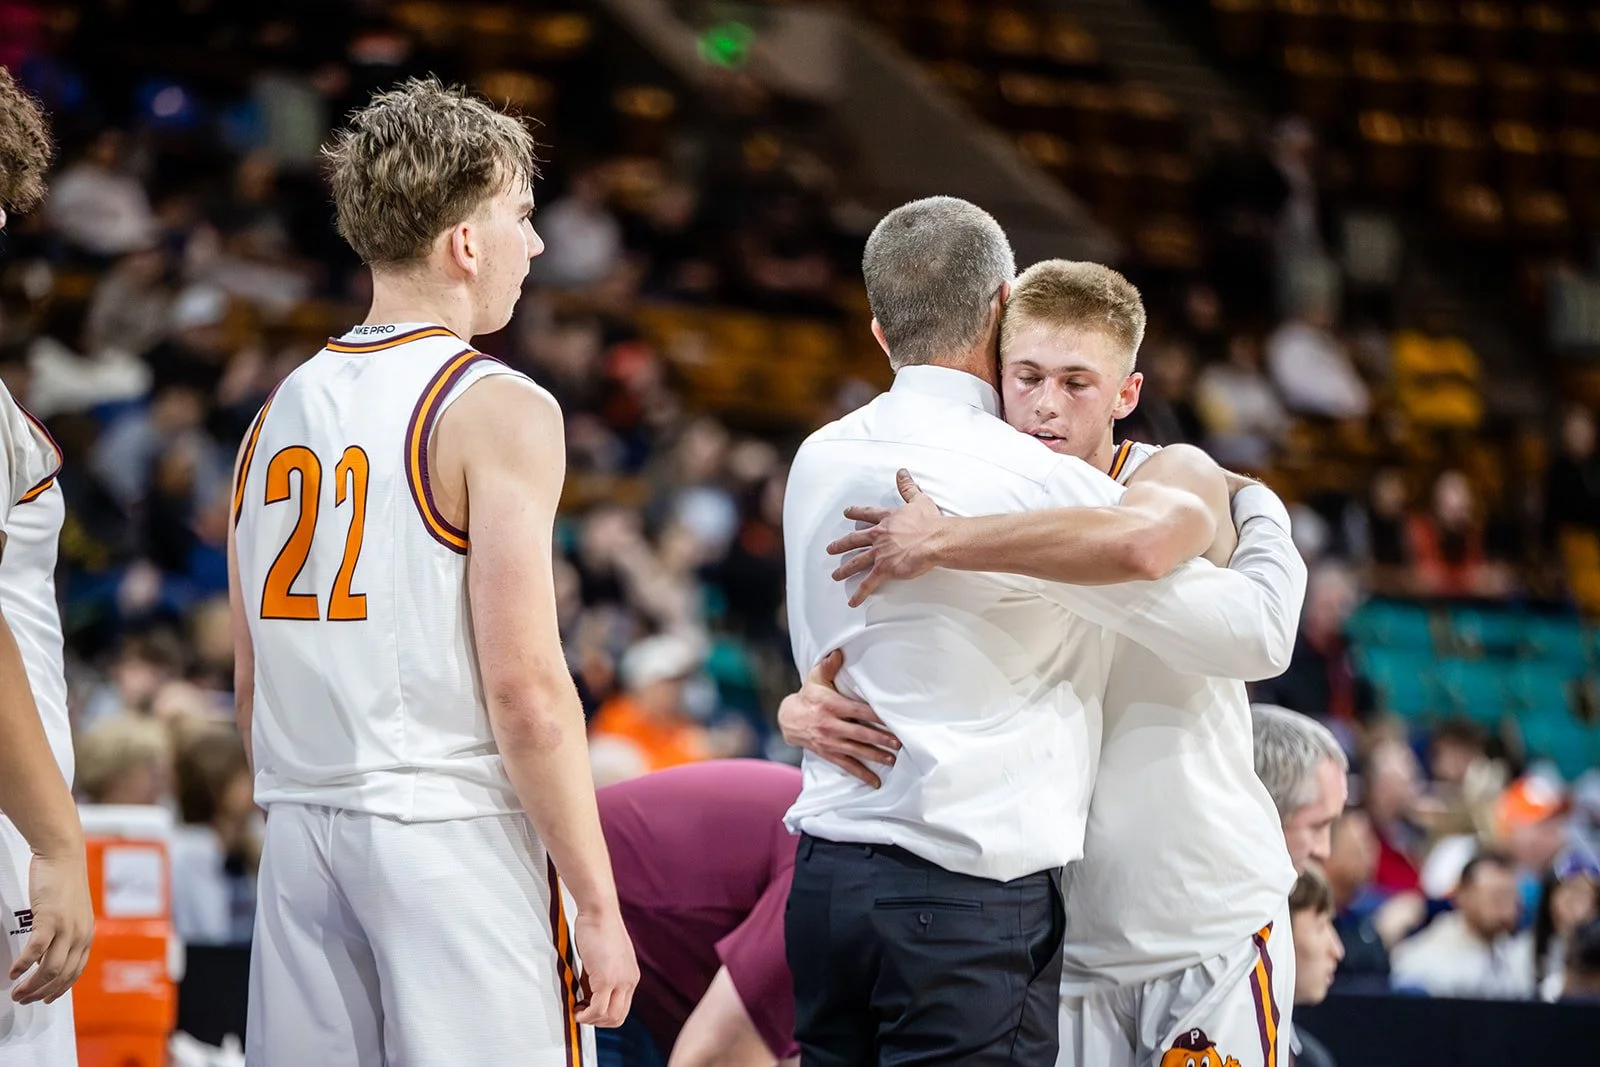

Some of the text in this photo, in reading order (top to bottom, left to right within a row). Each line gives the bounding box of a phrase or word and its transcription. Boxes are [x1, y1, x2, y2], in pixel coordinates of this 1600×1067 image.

[370, 325, 396, 334] PRO
[260, 445, 370, 622] 22
[1190, 1029, 1200, 1045] P
